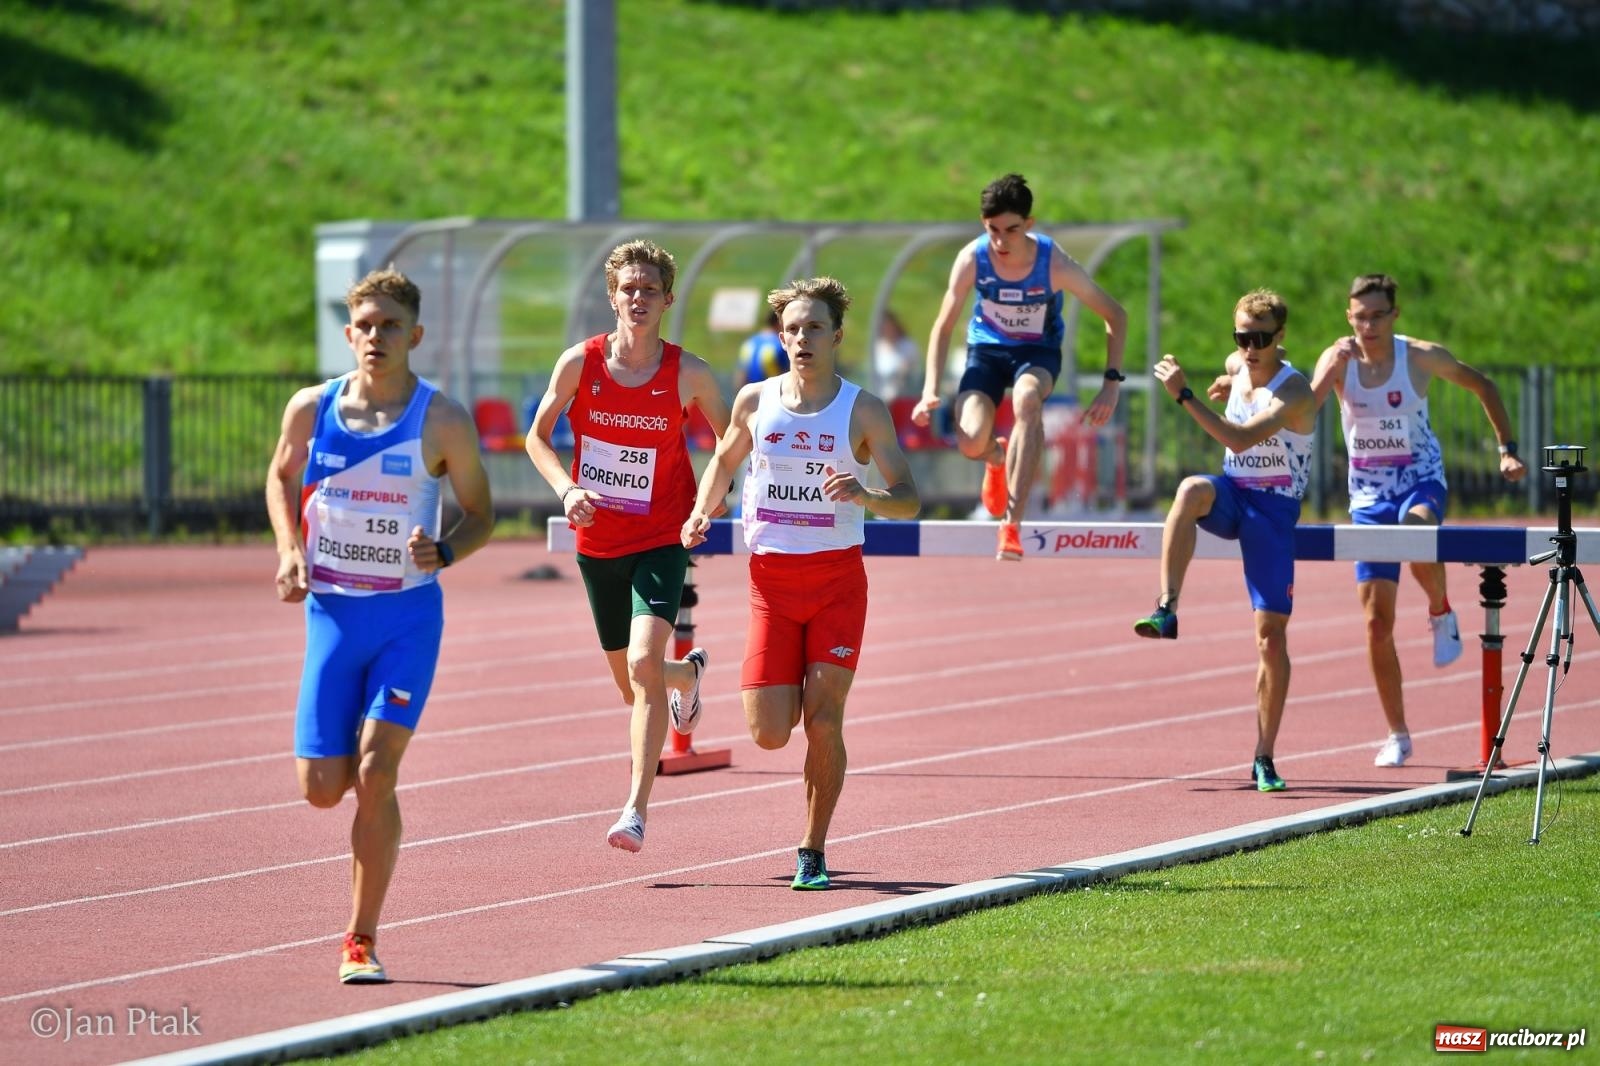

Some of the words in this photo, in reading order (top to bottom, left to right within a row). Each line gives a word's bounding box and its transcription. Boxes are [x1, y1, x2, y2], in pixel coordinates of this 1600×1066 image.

[589, 409, 668, 431] MAGYARORSZÁG
[1379, 419, 1402, 430] 361
[764, 432, 785, 443] 4F
[791, 443, 811, 451] ORLEN
[619, 449, 648, 464] 258
[1228, 452, 1286, 468] HVOZDÍK
[581, 463, 649, 489] GORENFLO
[805, 462, 825, 475] 57
[351, 489, 408, 504] REPUBLIC
[768, 484, 823, 502] RULKA
[365, 518, 399, 535] 158
[1055, 530, 1140, 552] polanik
[318, 536, 402, 564] EDELSBERGER
[829, 646, 855, 658] 4F
